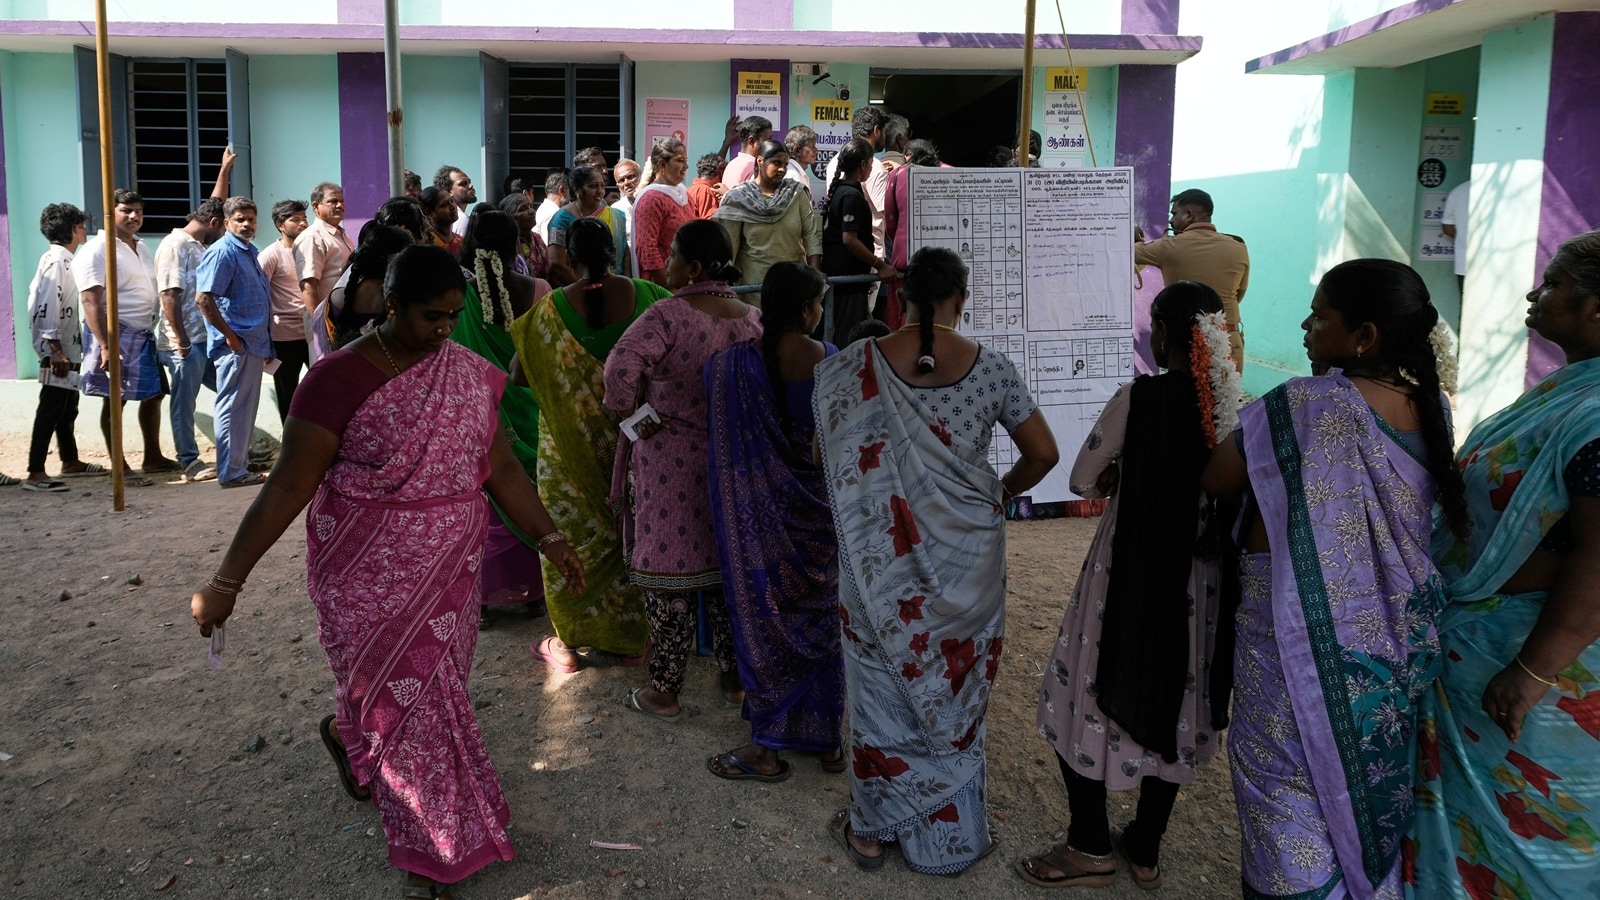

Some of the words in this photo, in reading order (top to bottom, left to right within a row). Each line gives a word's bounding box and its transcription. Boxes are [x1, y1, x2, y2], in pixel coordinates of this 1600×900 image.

[815, 106, 849, 121] FEMALE
[1046, 133, 1085, 150] ஆண்கள்
[817, 151, 834, 161] 005
[1420, 173, 1441, 185] 435
